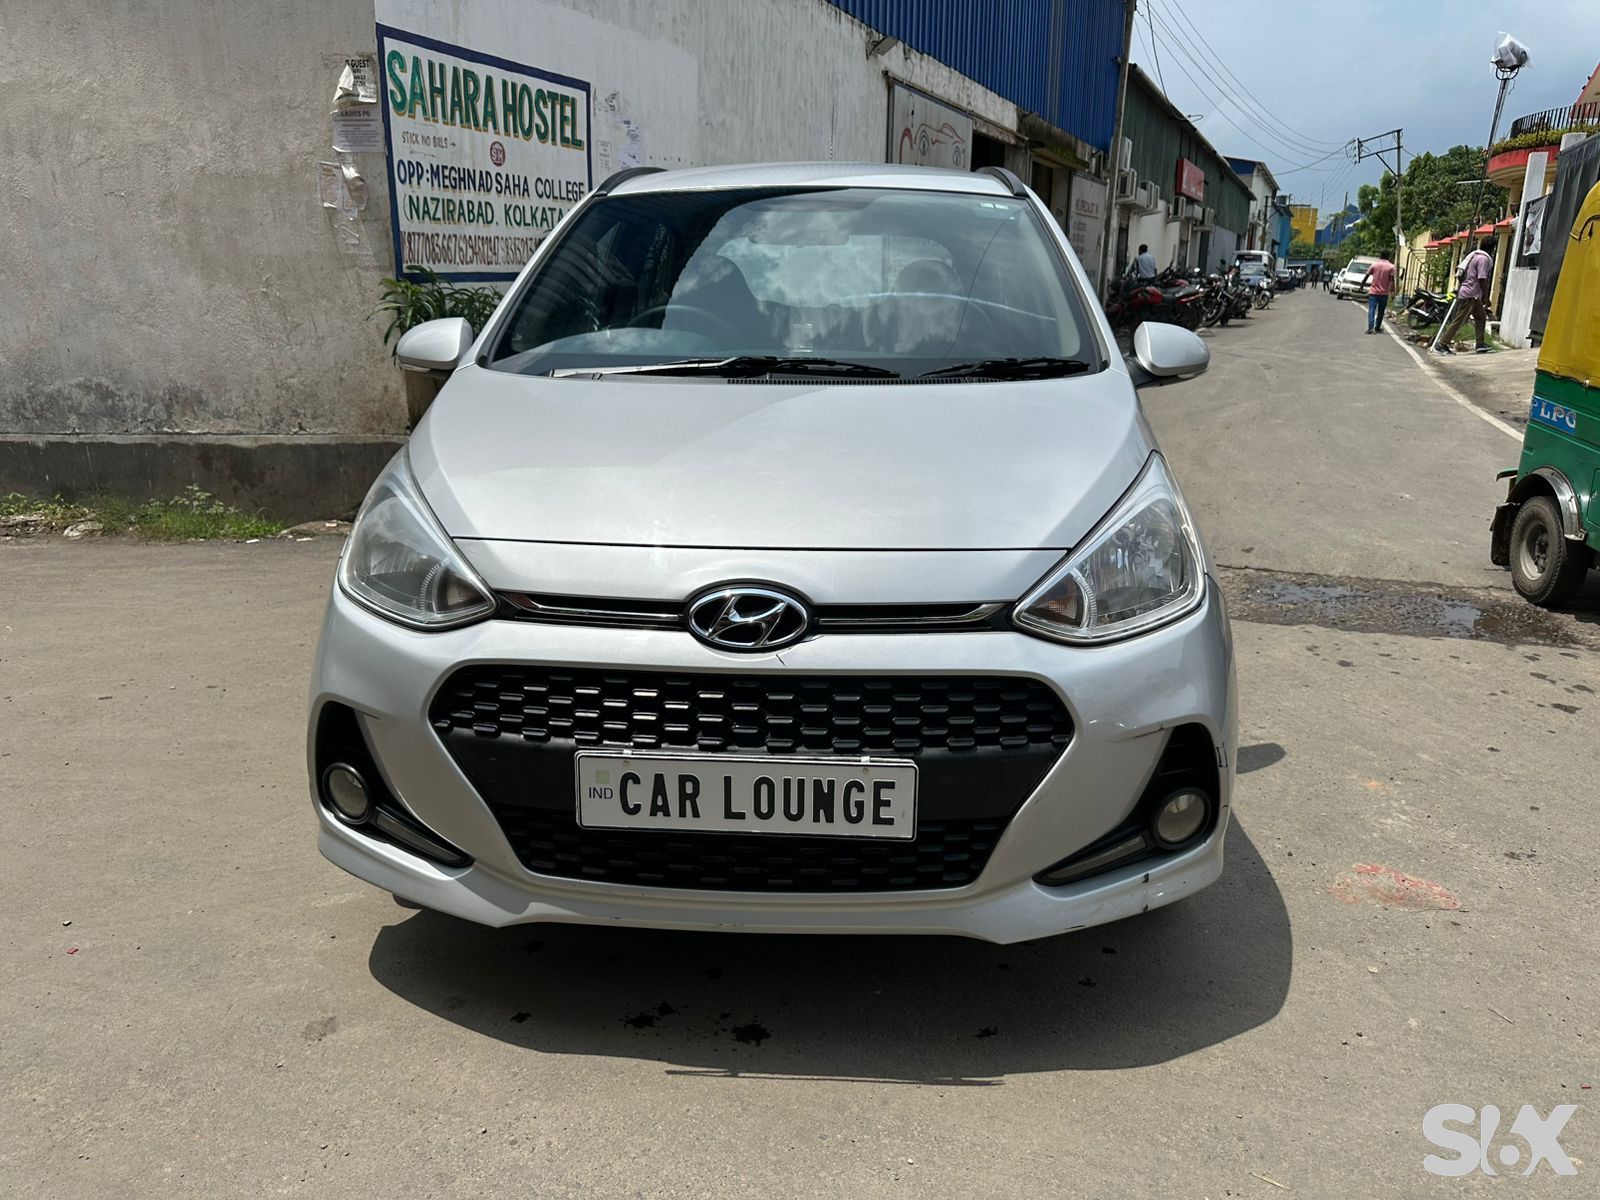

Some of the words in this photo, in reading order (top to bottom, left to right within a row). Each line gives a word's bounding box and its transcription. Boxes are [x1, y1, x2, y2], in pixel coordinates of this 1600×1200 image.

[387, 50, 500, 135] SAHARA
[501, 79, 585, 150] HOSTEL
[401, 130, 419, 145] STICK
[421, 134, 431, 146] NO
[495, 172, 530, 198] SAHA
[535, 177, 584, 202] COLLEGE
[1540, 401, 1577, 428] LPG
[588, 786, 614, 800] IND
[619, 771, 701, 819] CAR
[723, 775, 897, 826] LOUNGE
